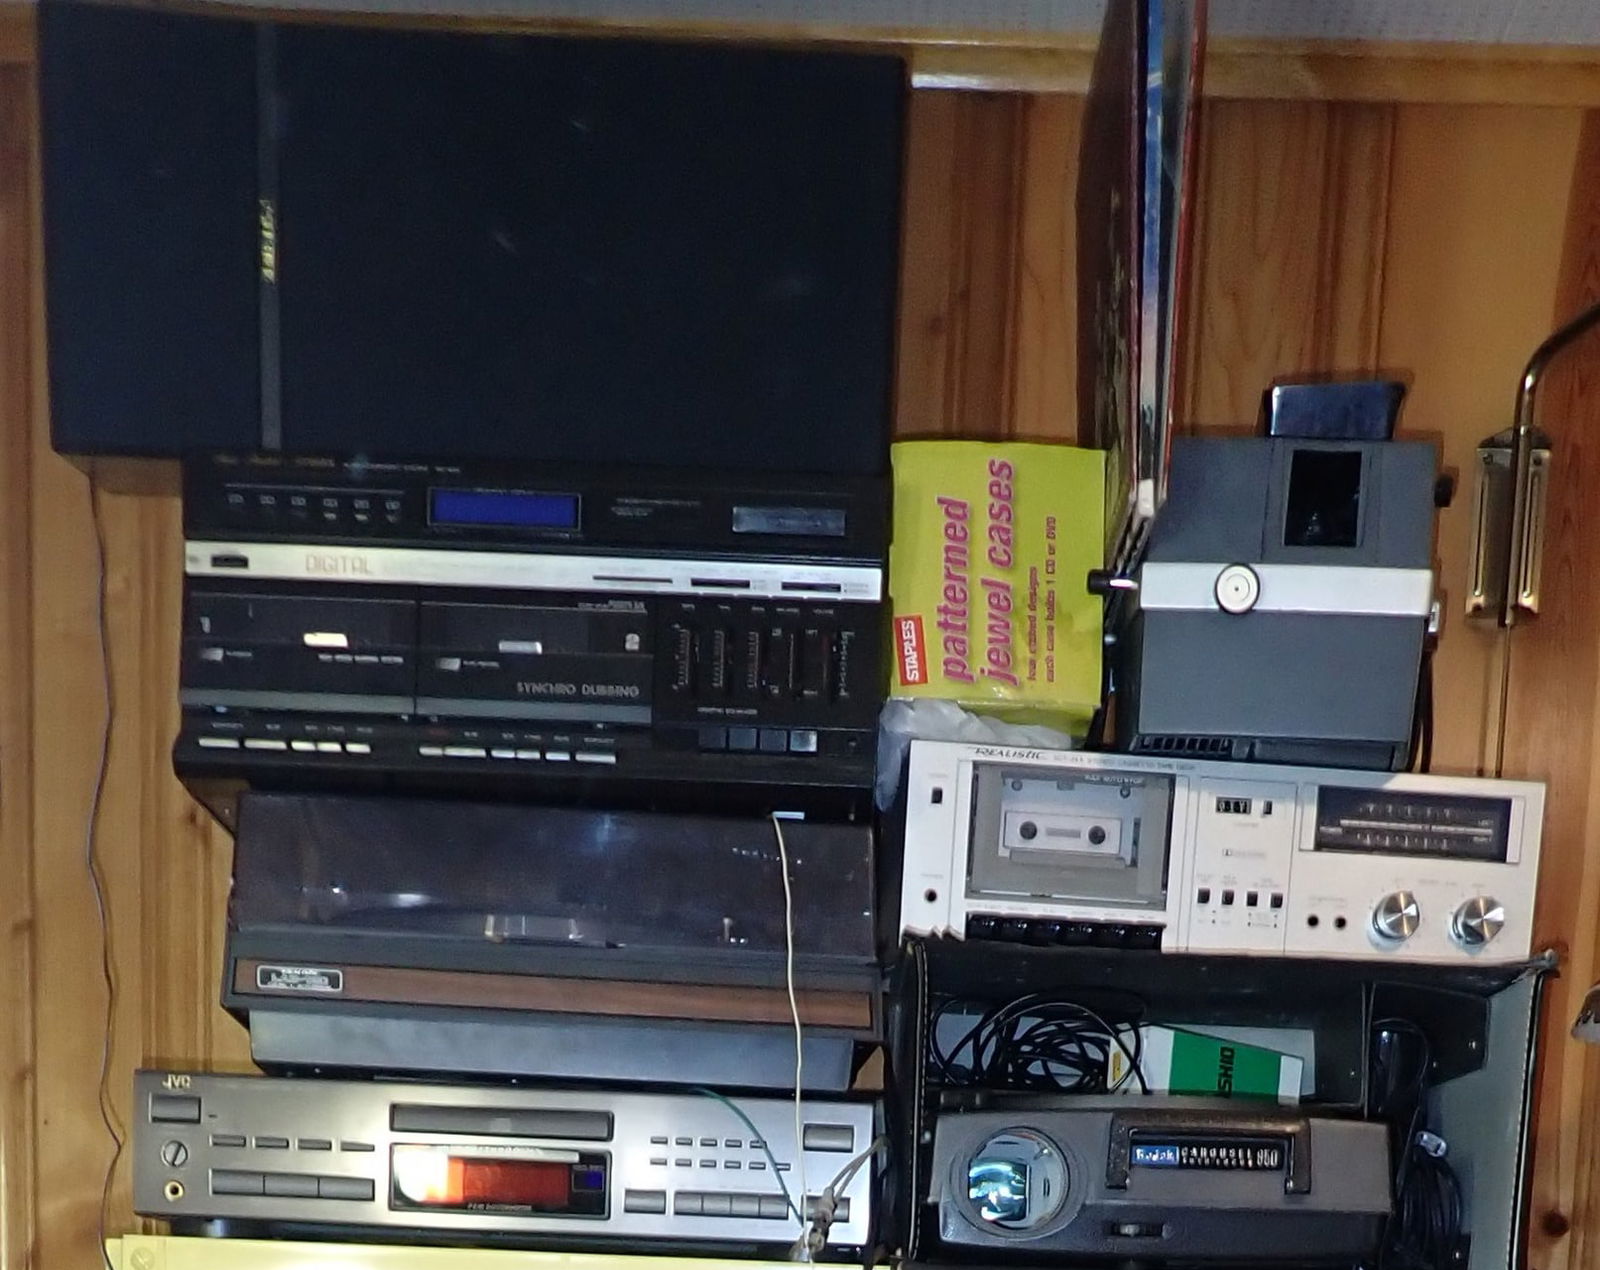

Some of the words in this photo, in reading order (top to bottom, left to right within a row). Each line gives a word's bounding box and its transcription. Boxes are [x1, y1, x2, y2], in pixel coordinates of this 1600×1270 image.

[987, 458, 1014, 569] cases
[304, 554, 375, 574] DIGITAL
[936, 495, 976, 684] patterned
[979, 577, 1020, 687] jewel
[901, 619, 919, 683] STAPLES
[517, 681, 577, 695] SYNCHRO
[582, 684, 640, 698] DUBBING
[975, 747, 1043, 761] REALISTIC
[163, 1074, 191, 1089] JVC
[1135, 1148, 1176, 1162] Kodak
